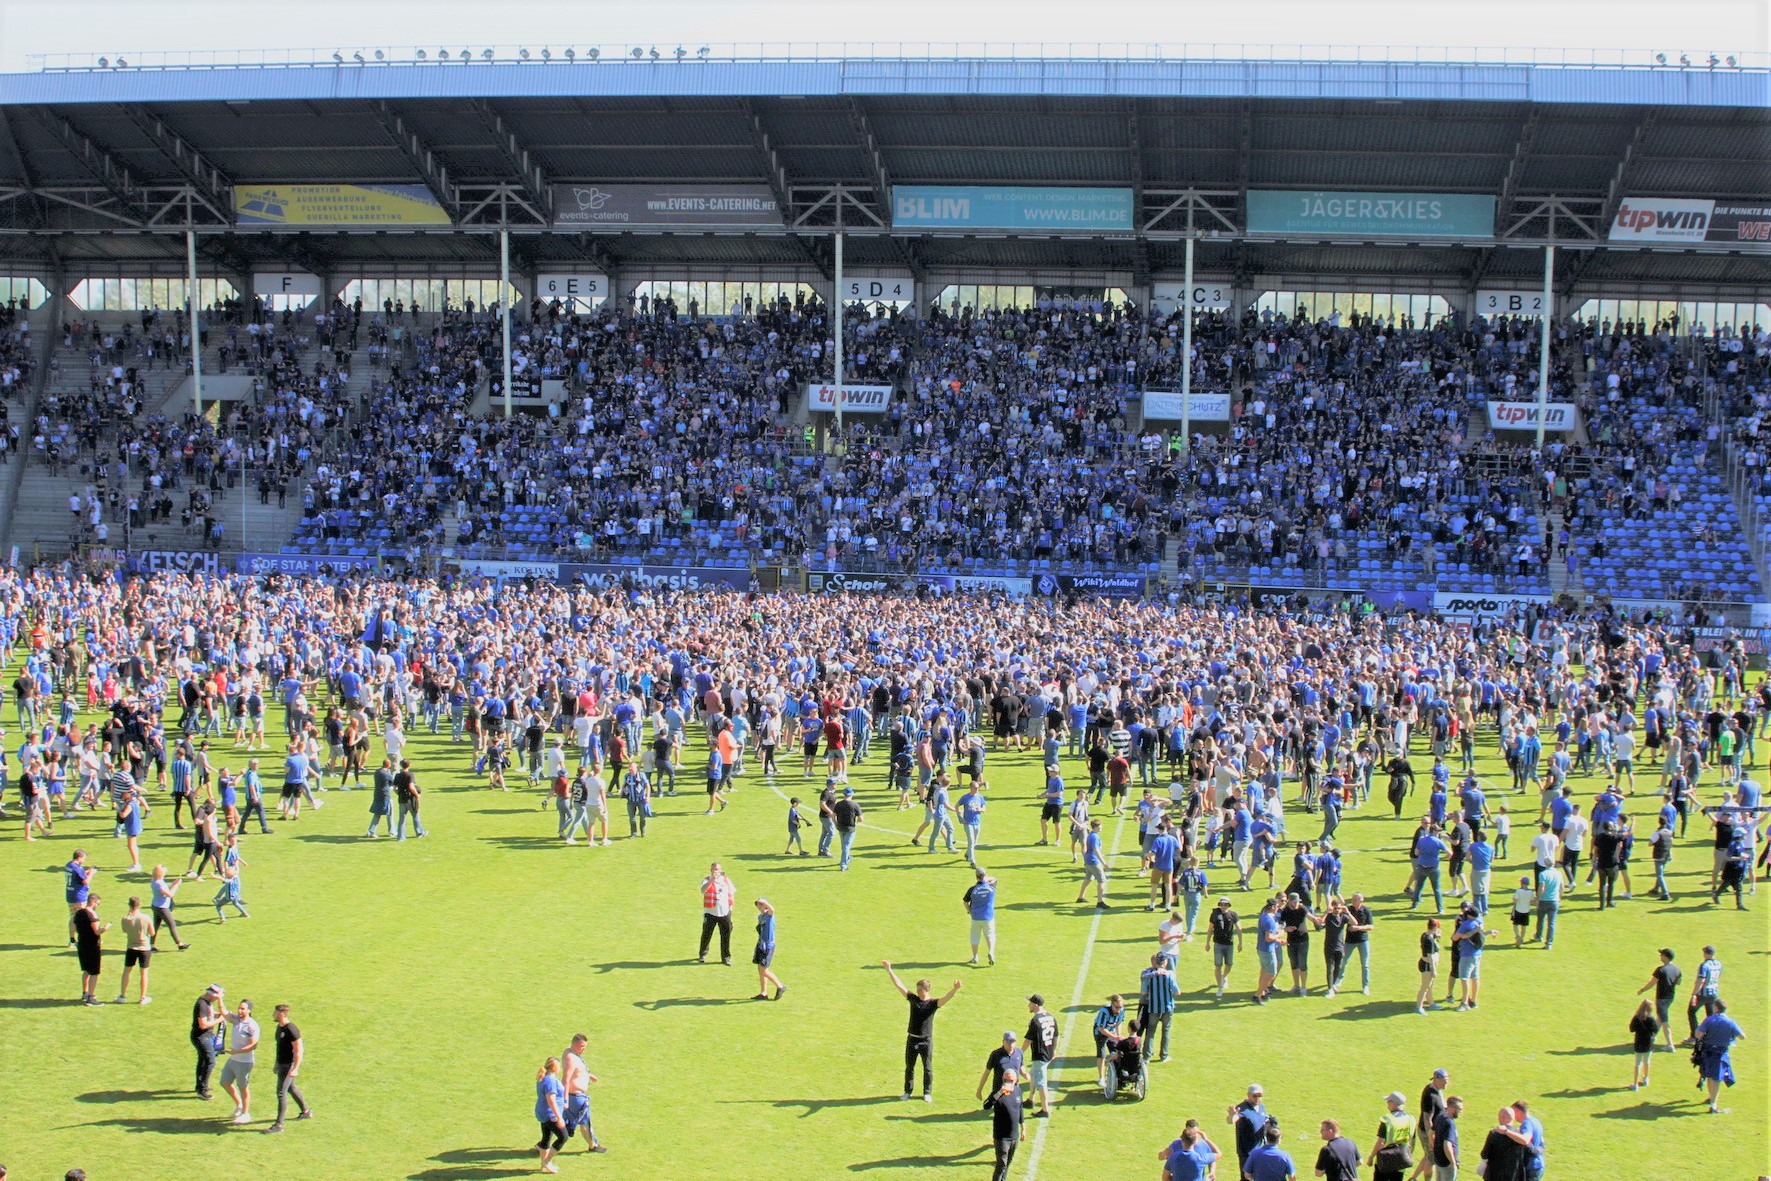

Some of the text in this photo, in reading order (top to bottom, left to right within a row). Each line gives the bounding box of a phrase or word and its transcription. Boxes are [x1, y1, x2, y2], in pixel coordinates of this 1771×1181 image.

[897, 198, 970, 219] BLIM
[1300, 192, 1442, 219] JÄGER&KIES
[1714, 206, 1729, 215] DIE
[1729, 207, 1762, 215] PUNKTE
[1024, 208, 1128, 222] WWW.BLIM.DE
[1617, 204, 1708, 233] tipwin
[282, 277, 292, 292] F
[549, 279, 596, 293] 6 E 5
[852, 282, 901, 297] 5 D 4
[1178, 288, 1221, 303] 4 C 3
[1489, 295, 1541, 310] 3 B 2
[1745, 628, 1758, 638] IN
